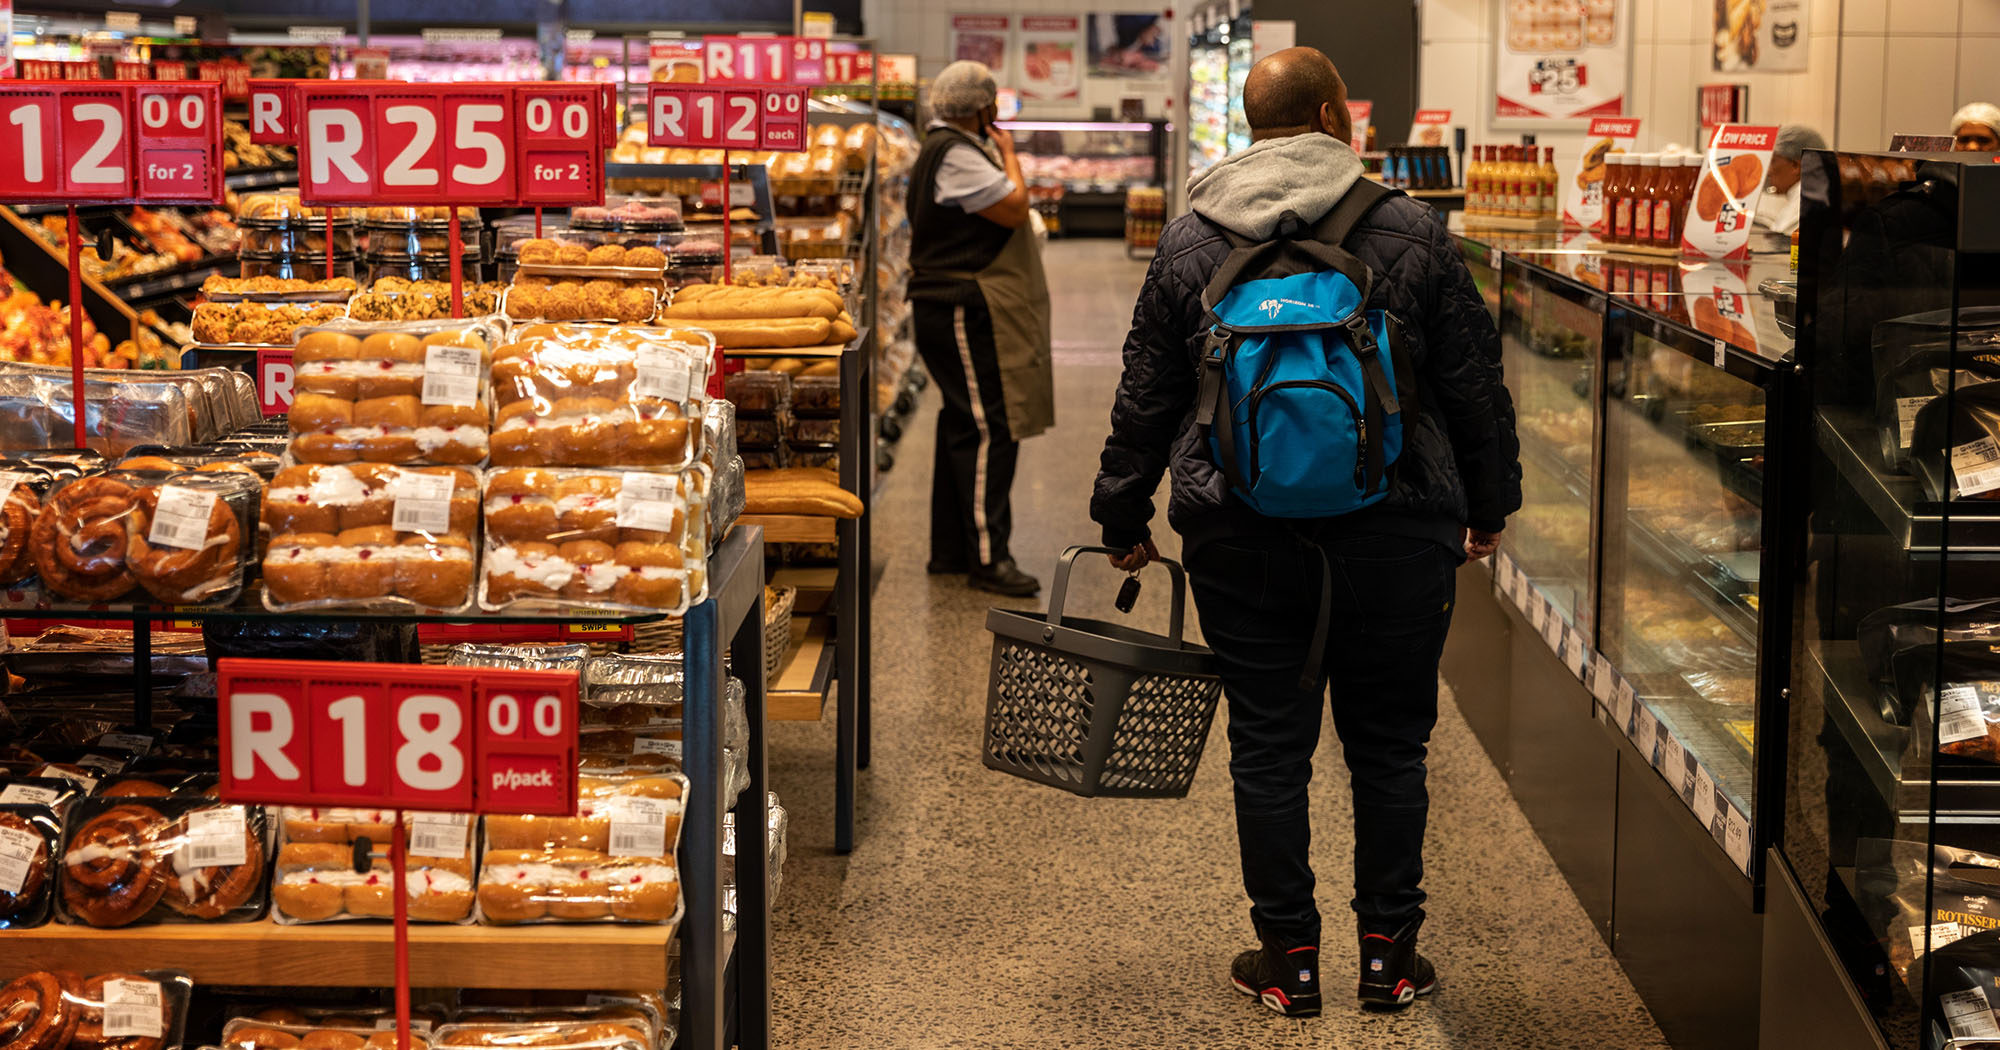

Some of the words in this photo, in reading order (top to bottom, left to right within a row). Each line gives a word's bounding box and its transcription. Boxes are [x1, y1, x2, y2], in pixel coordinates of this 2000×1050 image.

[707, 42, 783, 80] R11
[795, 42, 822, 60] 99
[654, 96, 757, 140] R12
[766, 94, 800, 113] 00
[9, 104, 125, 184] 12
[143, 97, 204, 129] 00
[308, 104, 505, 186] R25
[526, 98, 589, 138] 00
[767, 130, 795, 140] each
[1718, 132, 1740, 144] LOW
[1740, 133, 1768, 145] PRICE
[147, 163, 177, 180] for
[182, 164, 194, 180] 2
[534, 164, 564, 180] for
[568, 164, 581, 180] 2
[1719, 209, 1737, 232] R5
[581, 623, 608, 632] SWIPE
[230, 693, 464, 791] R18
[488, 695, 561, 737] 00
[491, 769, 554, 791] p/pack
